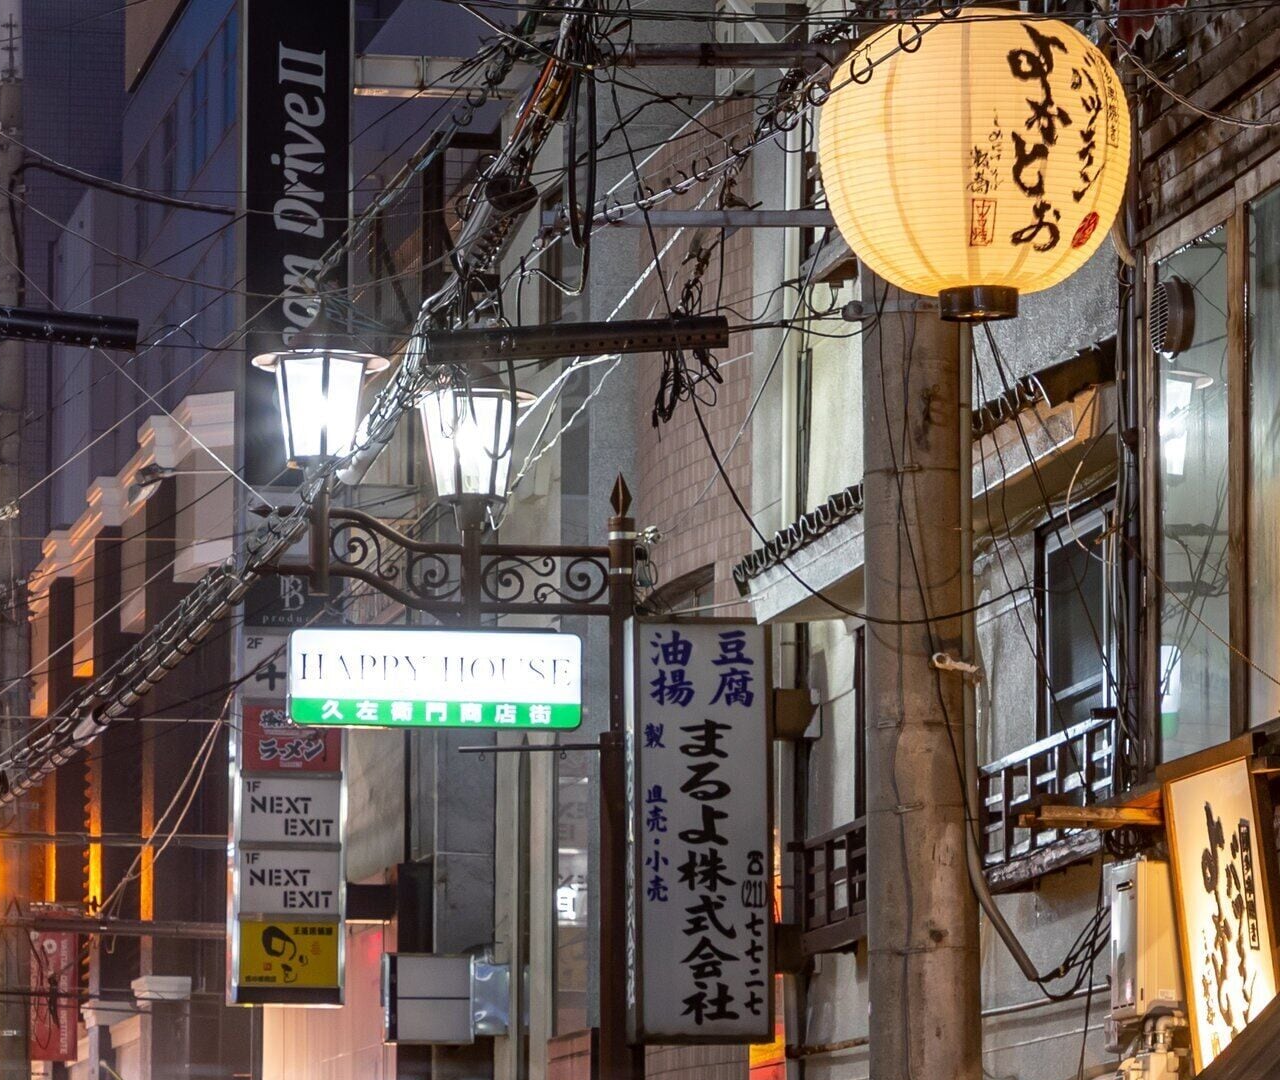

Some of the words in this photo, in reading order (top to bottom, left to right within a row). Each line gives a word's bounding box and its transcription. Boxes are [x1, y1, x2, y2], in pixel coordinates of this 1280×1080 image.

[300, 652, 426, 682] HAPPY
[443, 655, 573, 687] HOUSE
[650, 630, 695, 708] 油揚
[709, 630, 755, 708] 豆腐
[322, 699, 553, 726] 久左衛門商店街
[260, 738, 325, 761] ラーメン
[246, 781, 261, 793] 1F
[251, 796, 312, 814] NEXT
[284, 818, 334, 836] EXIT
[245, 853, 260, 864] 1F
[249, 869, 311, 886] NEXT
[677, 719, 741, 1025] まるよ株式会社
[283, 891, 333, 908] EXIT
